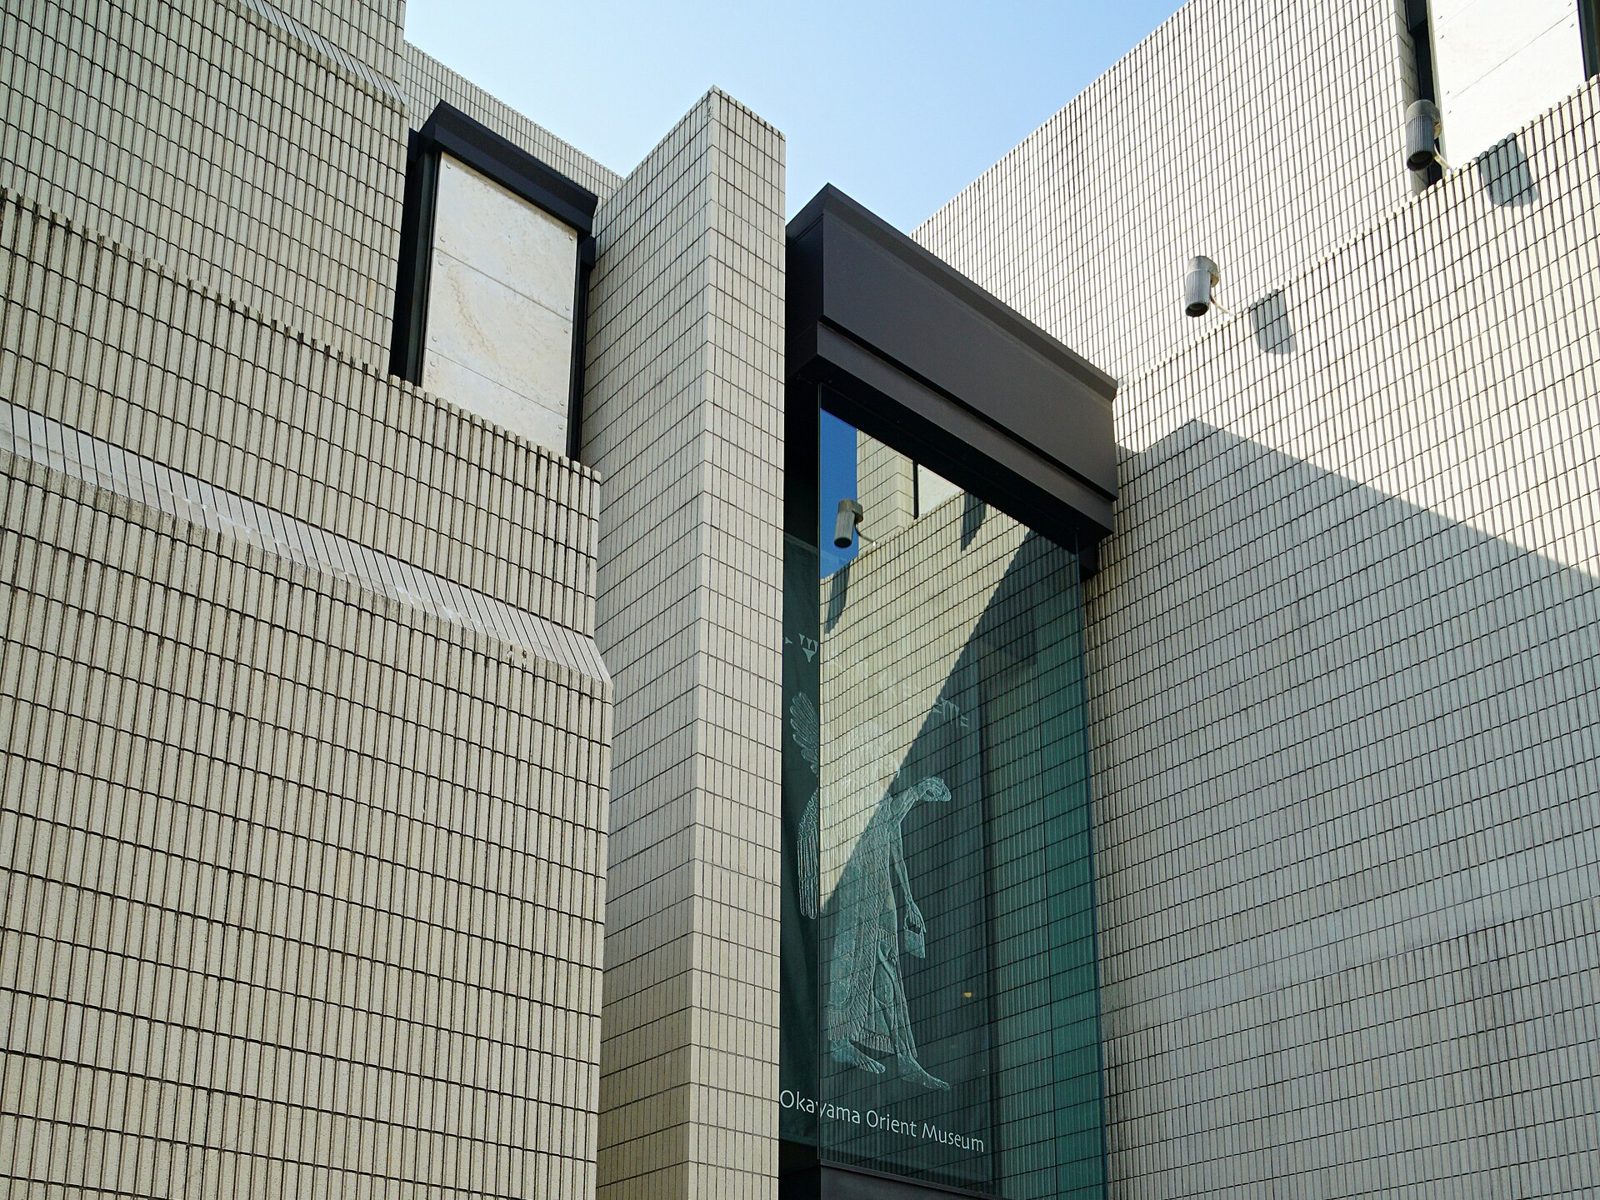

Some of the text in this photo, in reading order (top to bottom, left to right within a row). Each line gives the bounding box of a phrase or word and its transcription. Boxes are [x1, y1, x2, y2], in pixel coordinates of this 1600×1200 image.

[780, 1090, 984, 1152] Okayama Orient Museum
